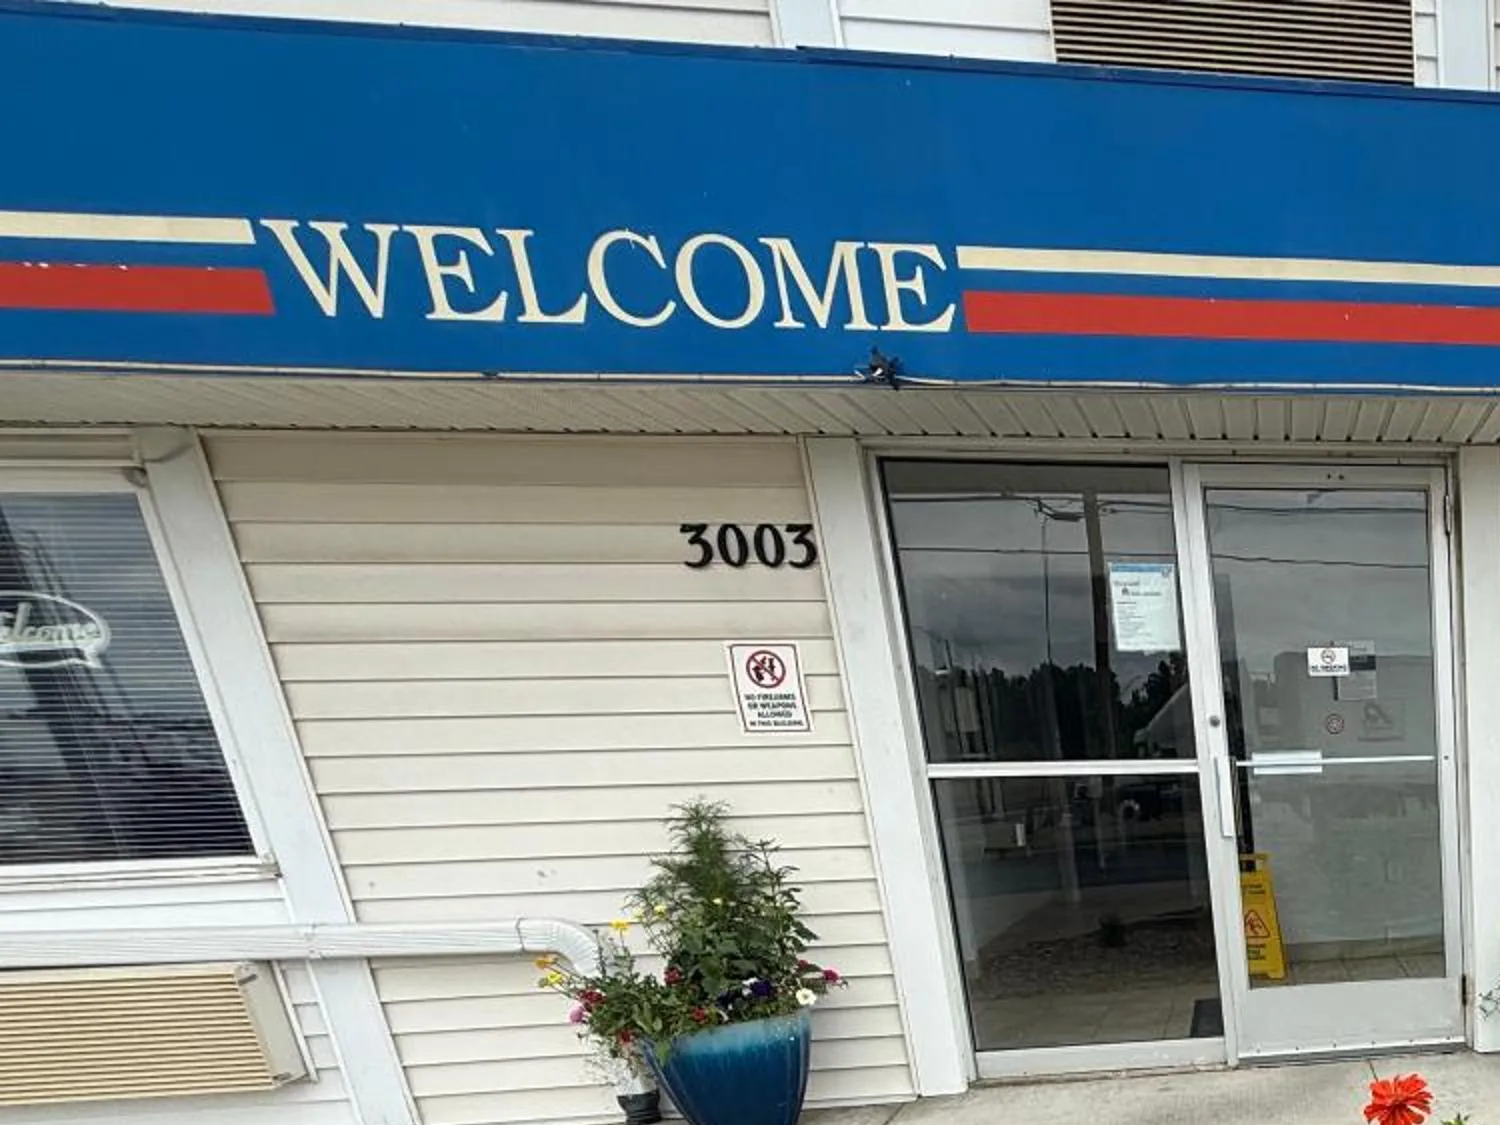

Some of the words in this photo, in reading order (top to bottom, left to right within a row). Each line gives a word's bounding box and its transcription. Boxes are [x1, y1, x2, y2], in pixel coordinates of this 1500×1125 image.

[260, 219, 956, 332] WELCOME
[679, 522, 818, 568] 3003
[0, 602, 101, 643] elcome
